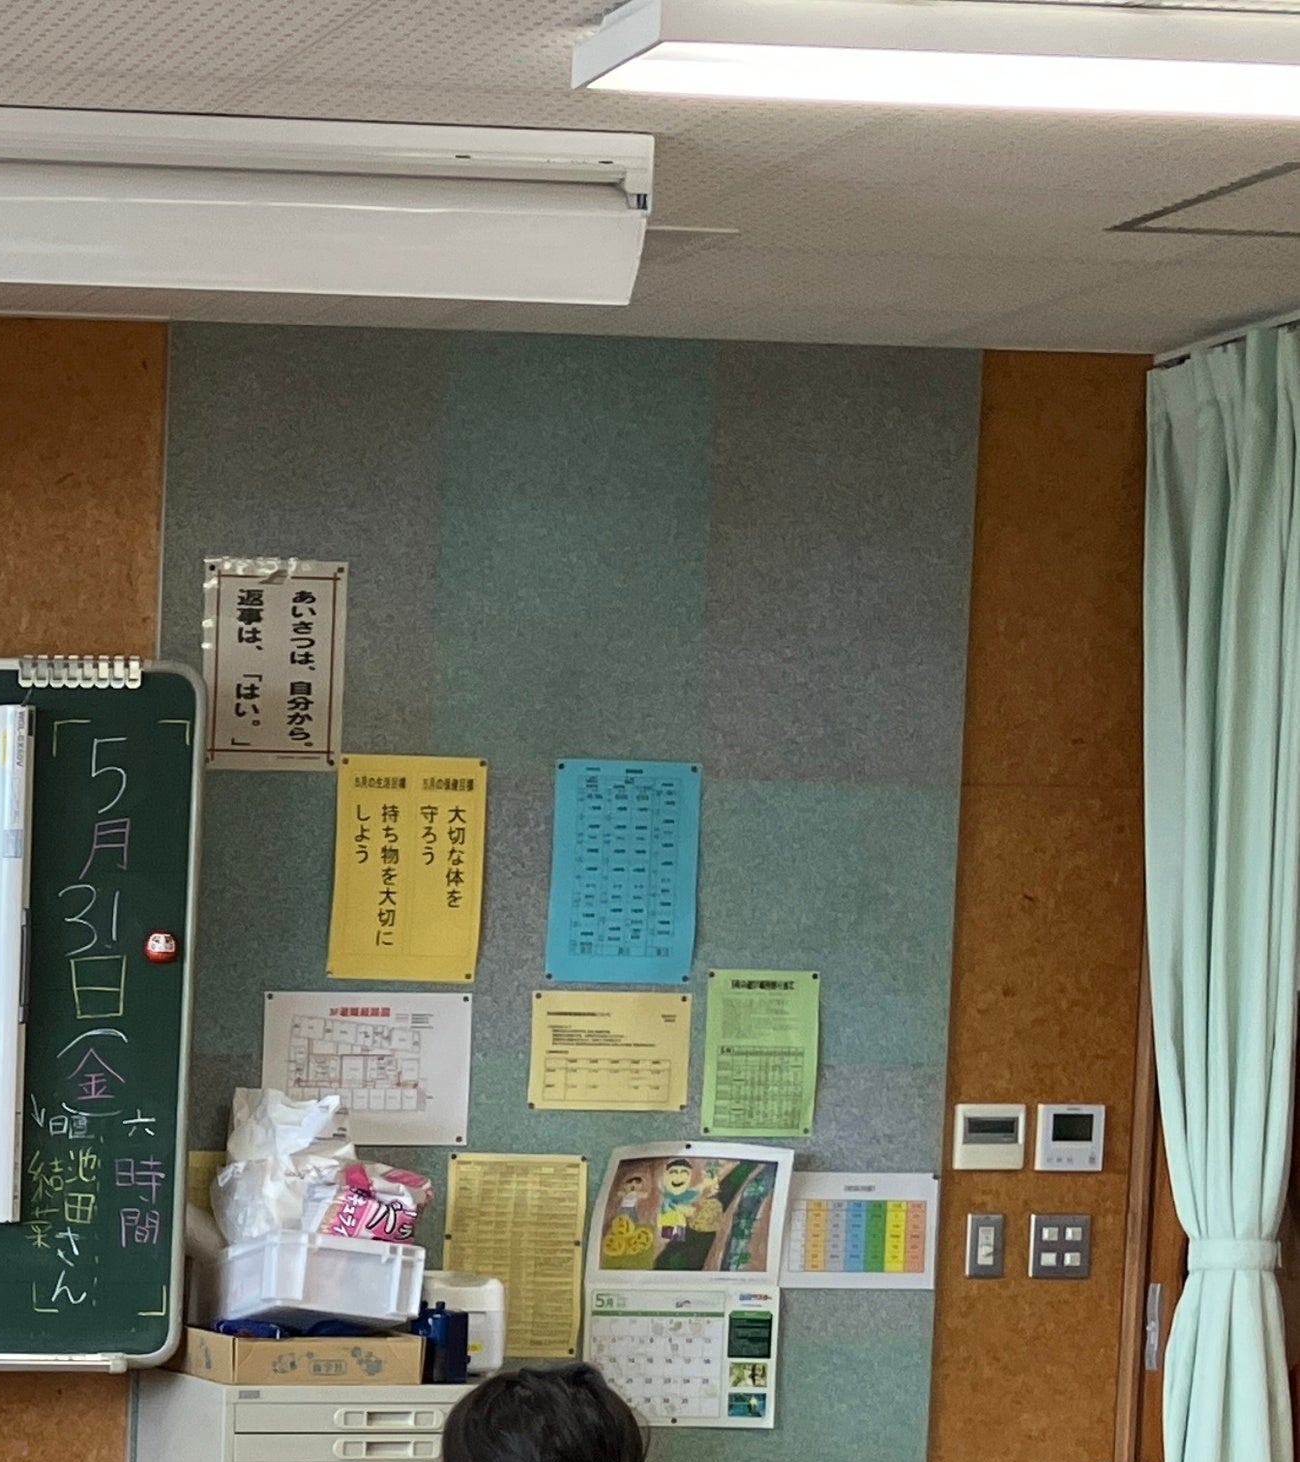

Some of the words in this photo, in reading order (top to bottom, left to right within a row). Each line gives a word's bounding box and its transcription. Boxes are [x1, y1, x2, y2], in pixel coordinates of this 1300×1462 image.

[287, 590, 317, 747] あいさつは、自分から。
[354, 804, 371, 864] しよう
[376, 804, 399, 946] 持ち物を大切に
[420, 805, 438, 865] 守ろう
[446, 805, 466, 908] 大切な体を
[114, 1108, 166, 1248] 六時間
